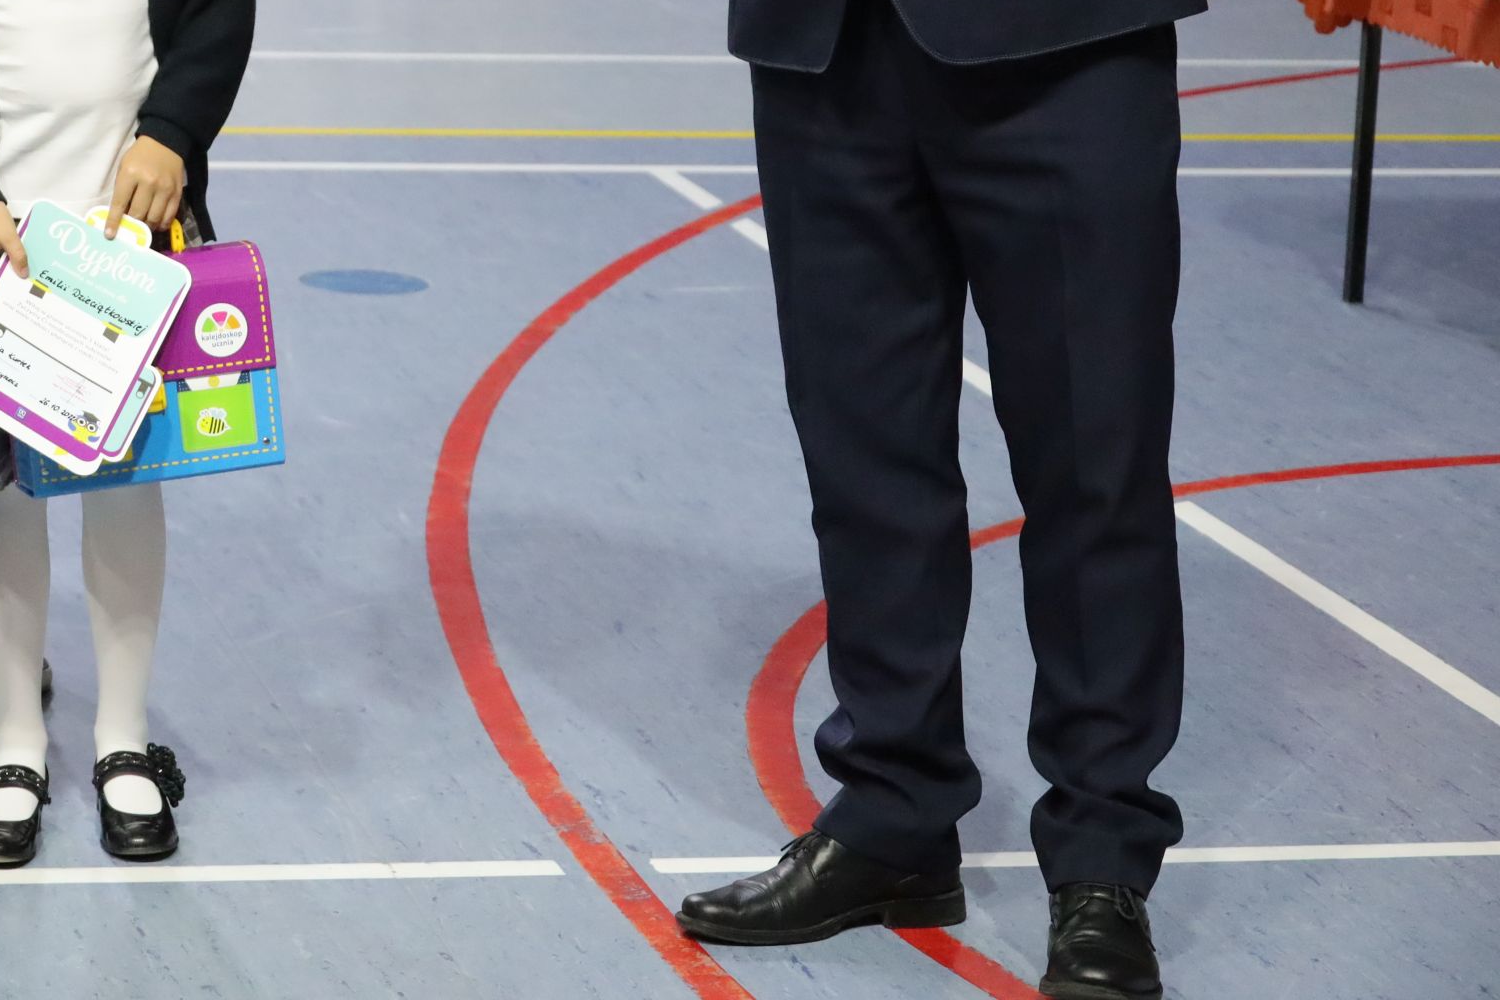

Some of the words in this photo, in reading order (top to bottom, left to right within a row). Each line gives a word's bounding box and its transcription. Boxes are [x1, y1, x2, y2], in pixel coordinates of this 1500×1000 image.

[48, 219, 156, 293] Dyplom
[201, 331, 243, 342] kalejdoskop
[211, 340, 234, 348] ucznia
